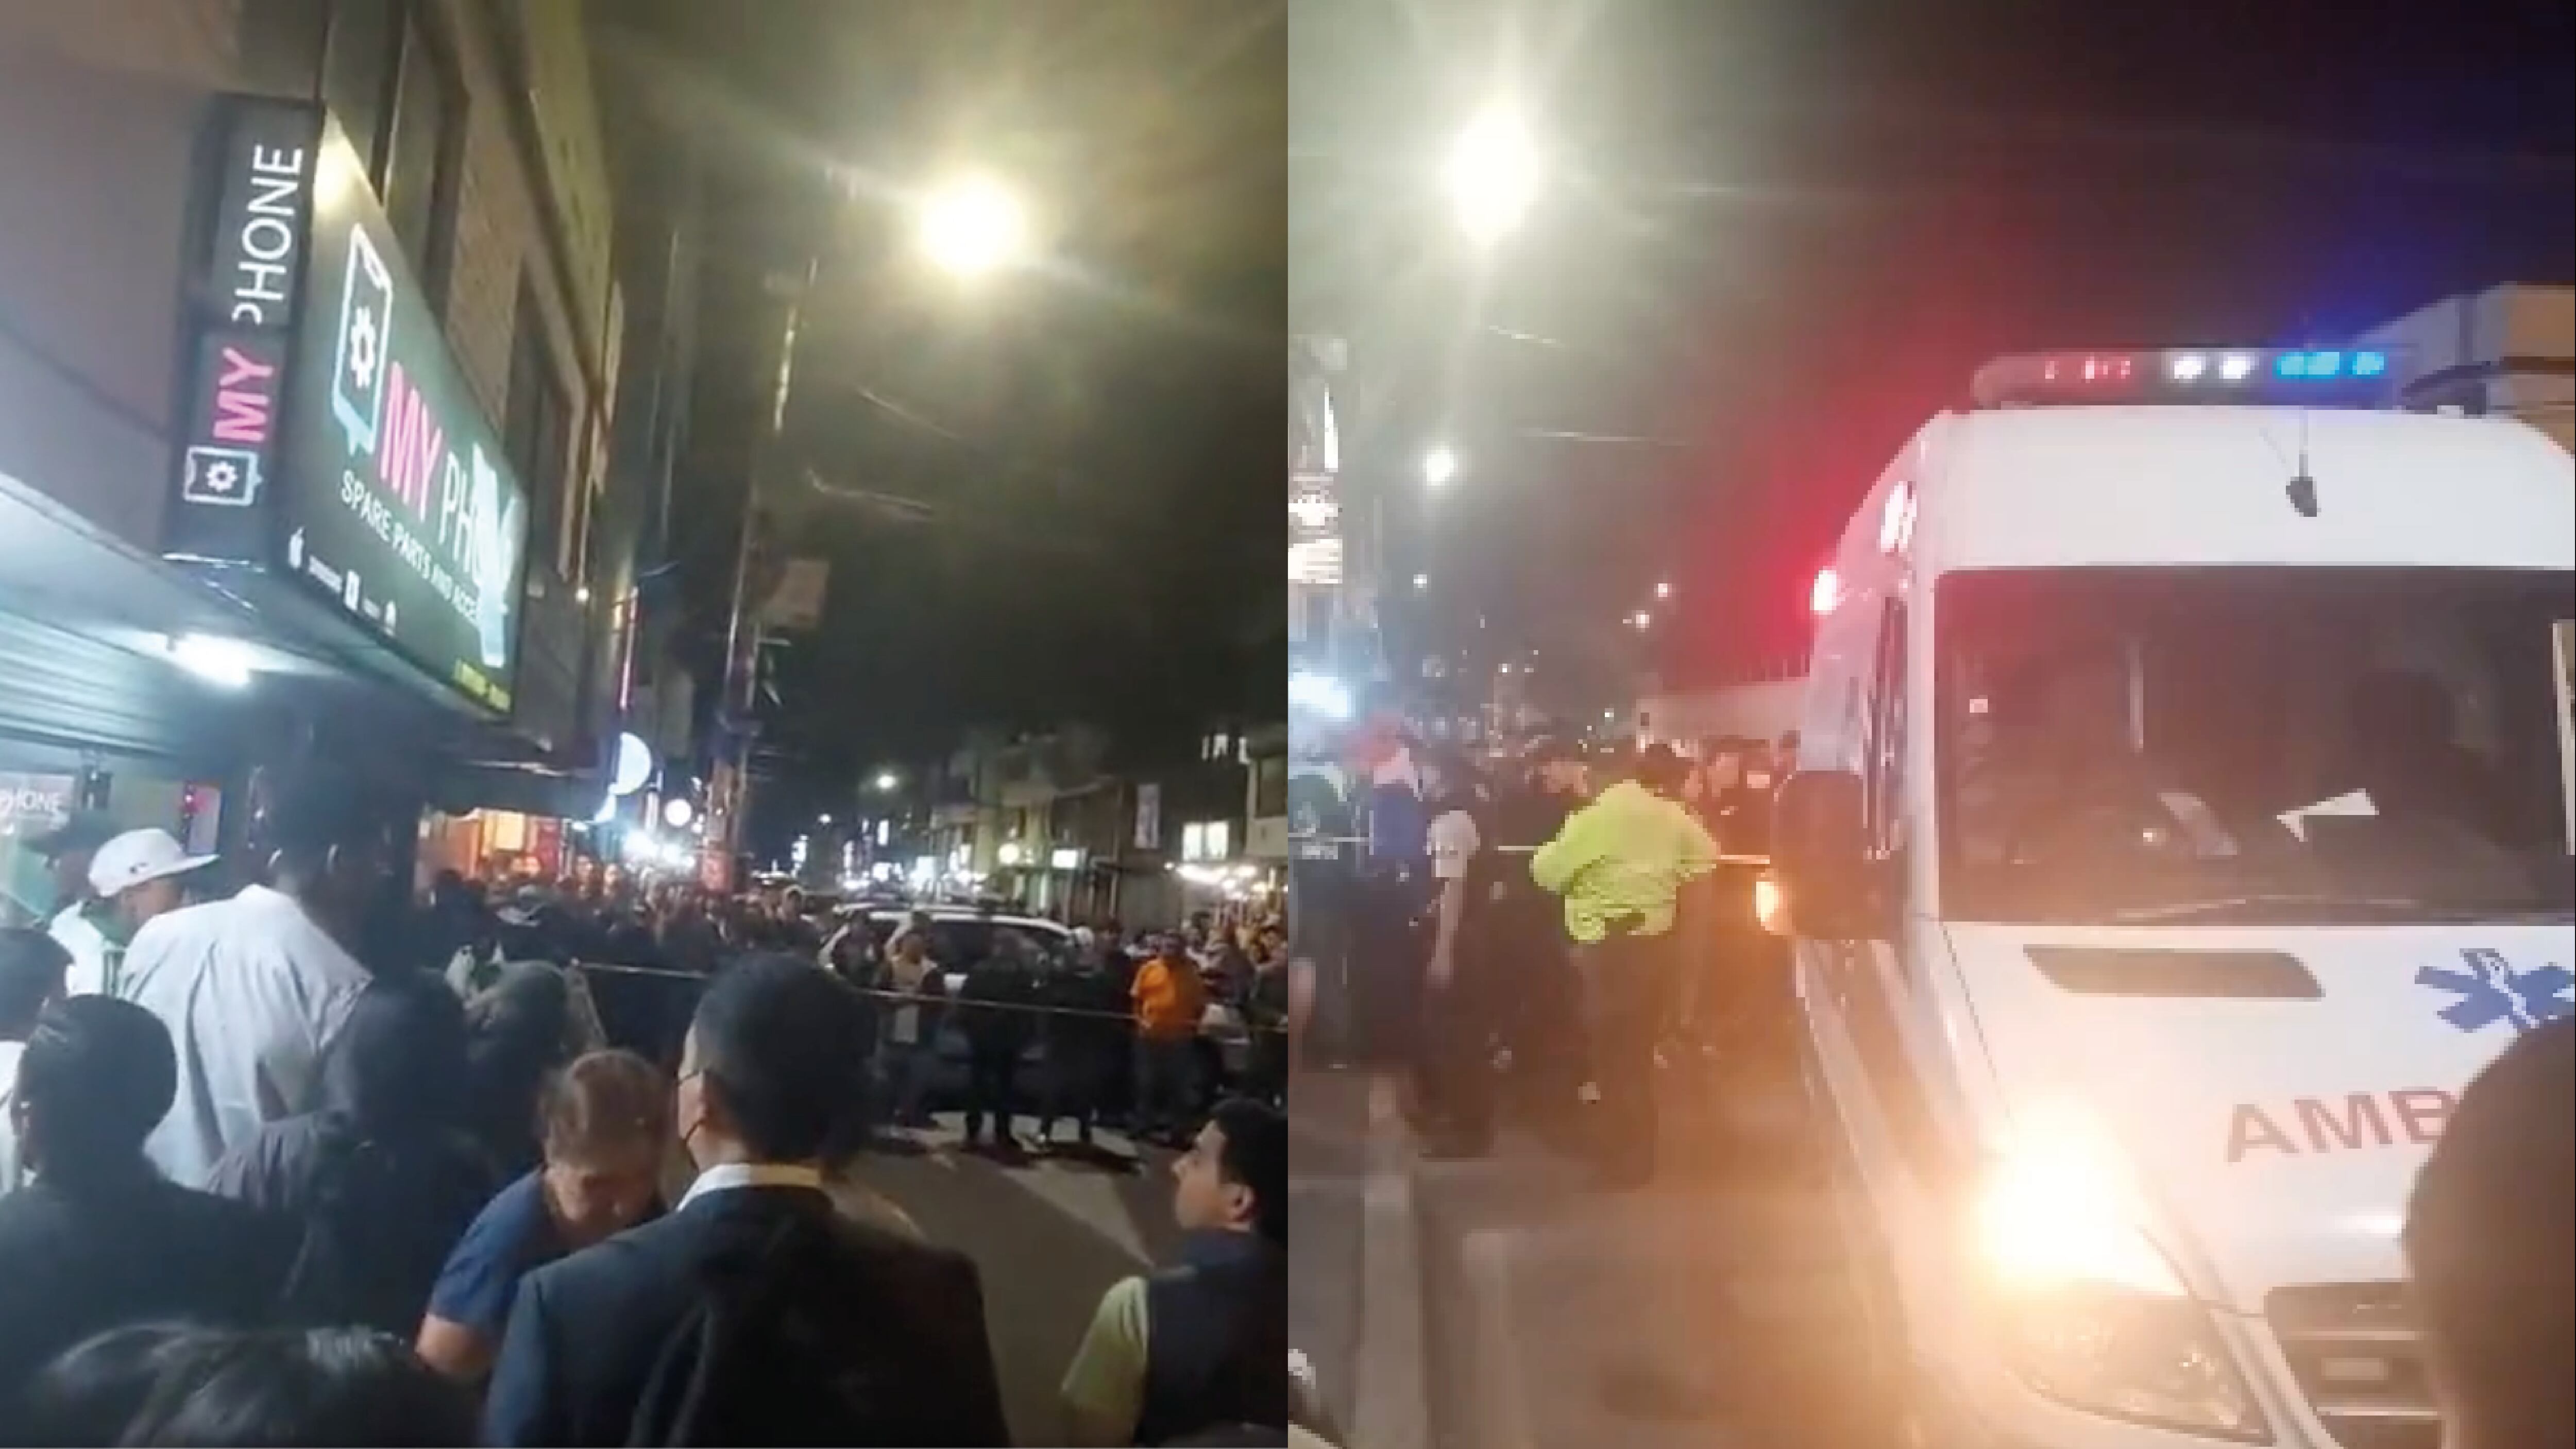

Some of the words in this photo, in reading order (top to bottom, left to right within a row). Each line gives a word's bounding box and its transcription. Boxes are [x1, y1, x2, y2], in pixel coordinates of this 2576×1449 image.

[213, 346, 274, 442] MY
[381, 361, 443, 523] MY
[342, 470, 392, 541] SPARE
[393, 522, 431, 579] PARTS
[2225, 1086, 2461, 1163] AMB
